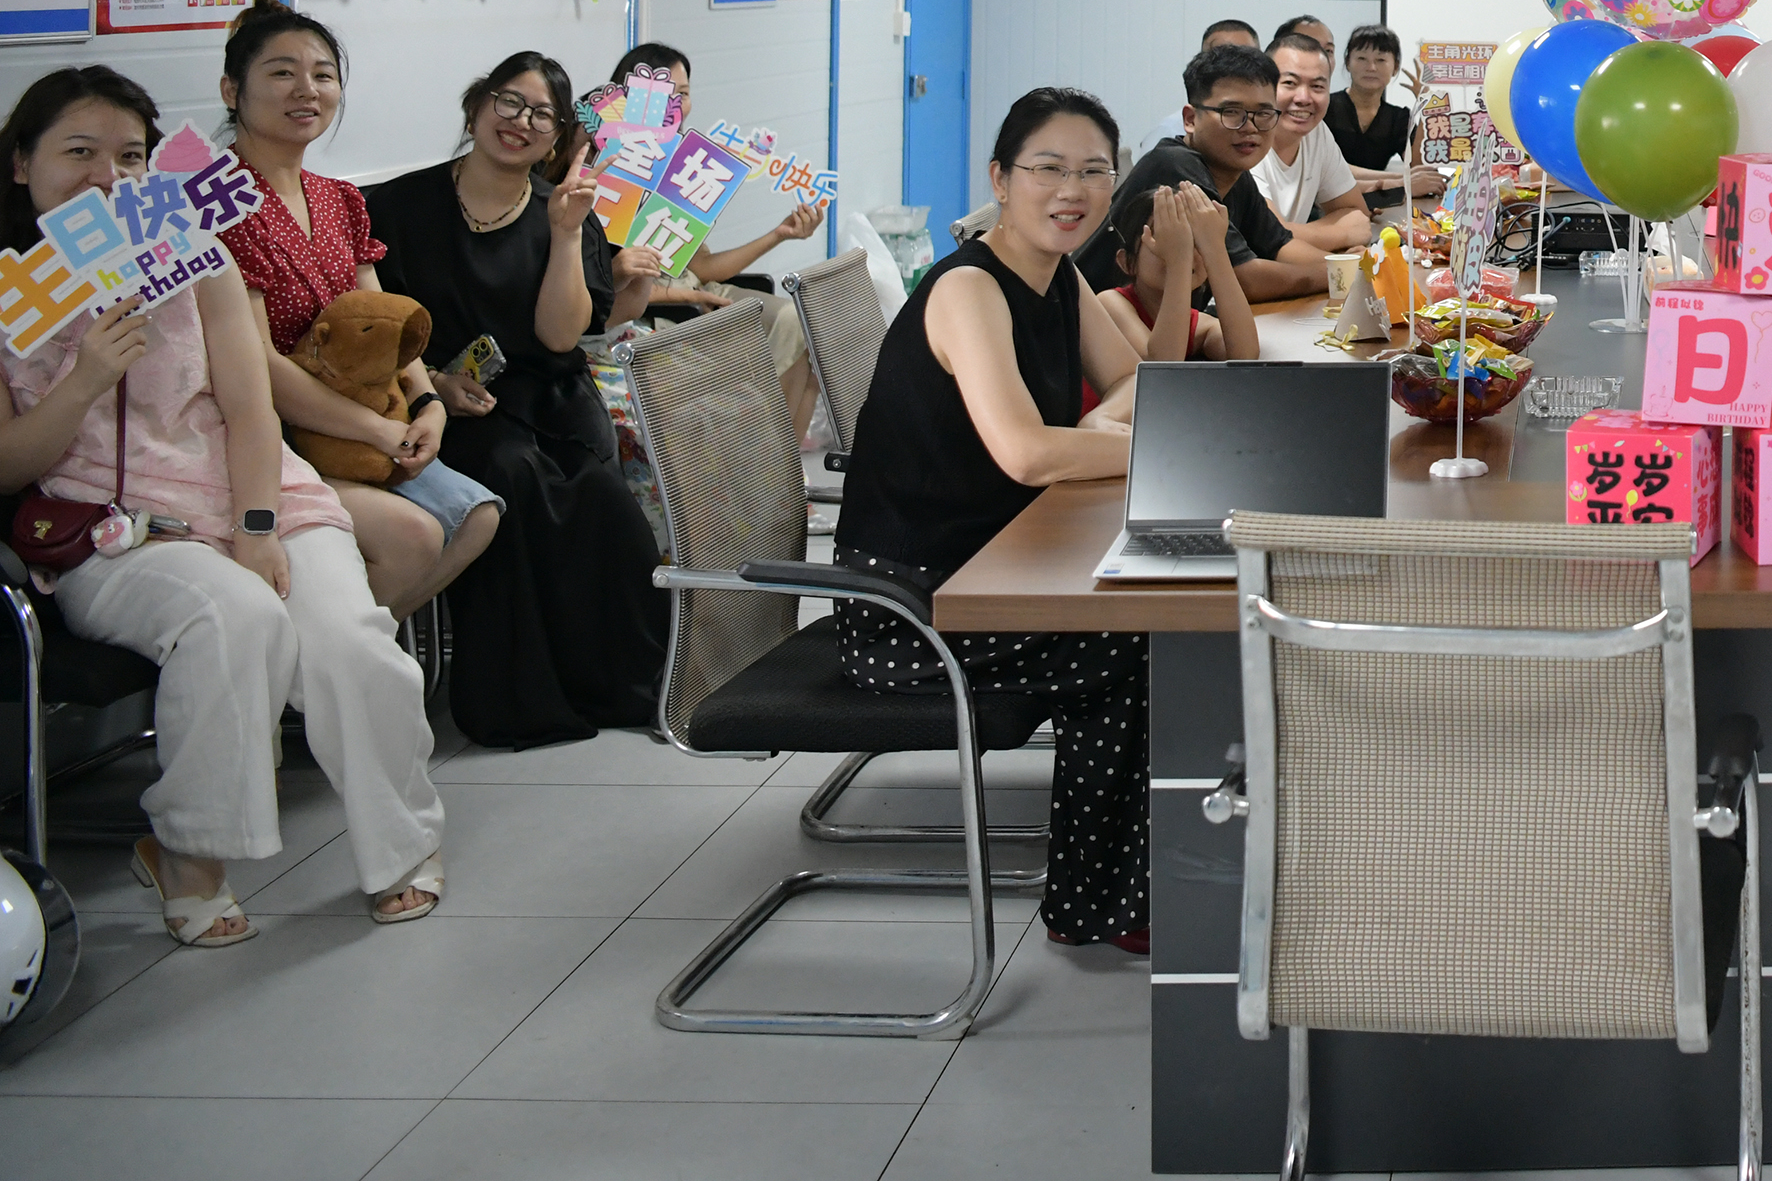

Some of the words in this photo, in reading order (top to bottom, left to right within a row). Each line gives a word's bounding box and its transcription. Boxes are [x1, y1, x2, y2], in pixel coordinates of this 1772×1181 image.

[1428, 45, 1493, 59] 主角光环
[617, 130, 735, 214] 全场
[1716, 181, 1739, 270] 快
[0, 153, 258, 352] 生日快乐
[97, 232, 192, 290] happy
[1655, 296, 1704, 311] 前程似锦
[1674, 314, 1748, 405] 日
[1707, 413, 1767, 425] BIRTHDAY
[1729, 402, 1768, 414] HAPPY
[1586, 451, 1673, 498] 岁岁
